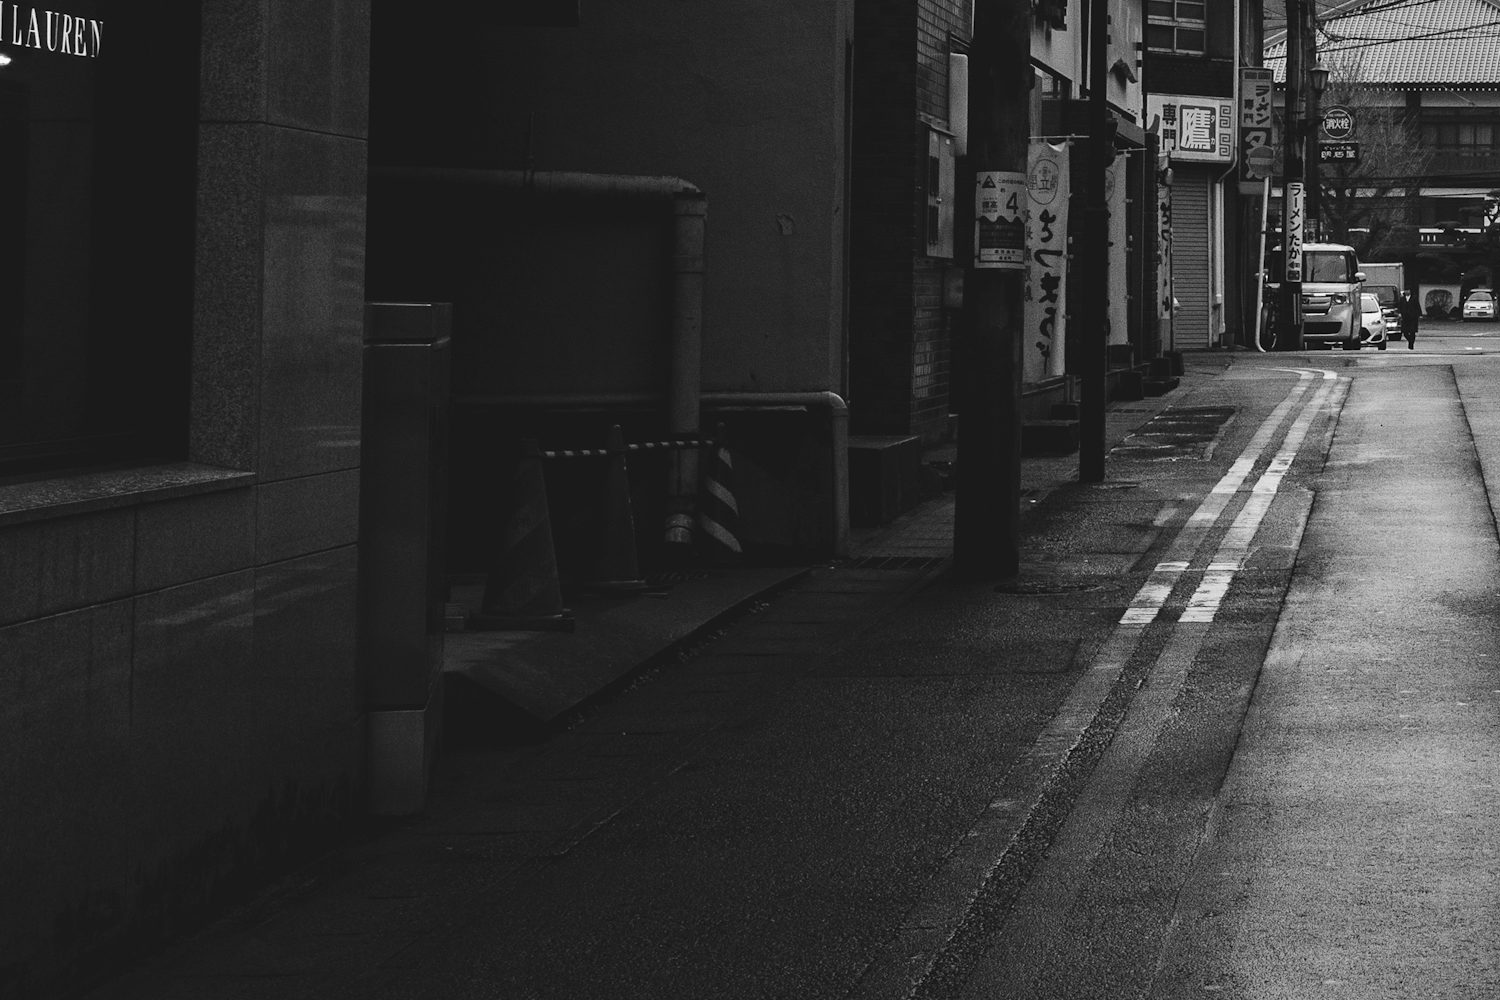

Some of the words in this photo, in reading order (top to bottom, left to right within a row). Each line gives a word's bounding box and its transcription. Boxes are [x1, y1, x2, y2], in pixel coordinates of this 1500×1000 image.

[12, 4, 104, 58] LAUREN
[1162, 103, 1177, 150] 専門
[1255, 85, 1270, 126] ラーメン
[1325, 118, 1349, 130] 消火栓
[1006, 192, 1019, 214] 4
[1289, 184, 1301, 260] ラーメンたか
